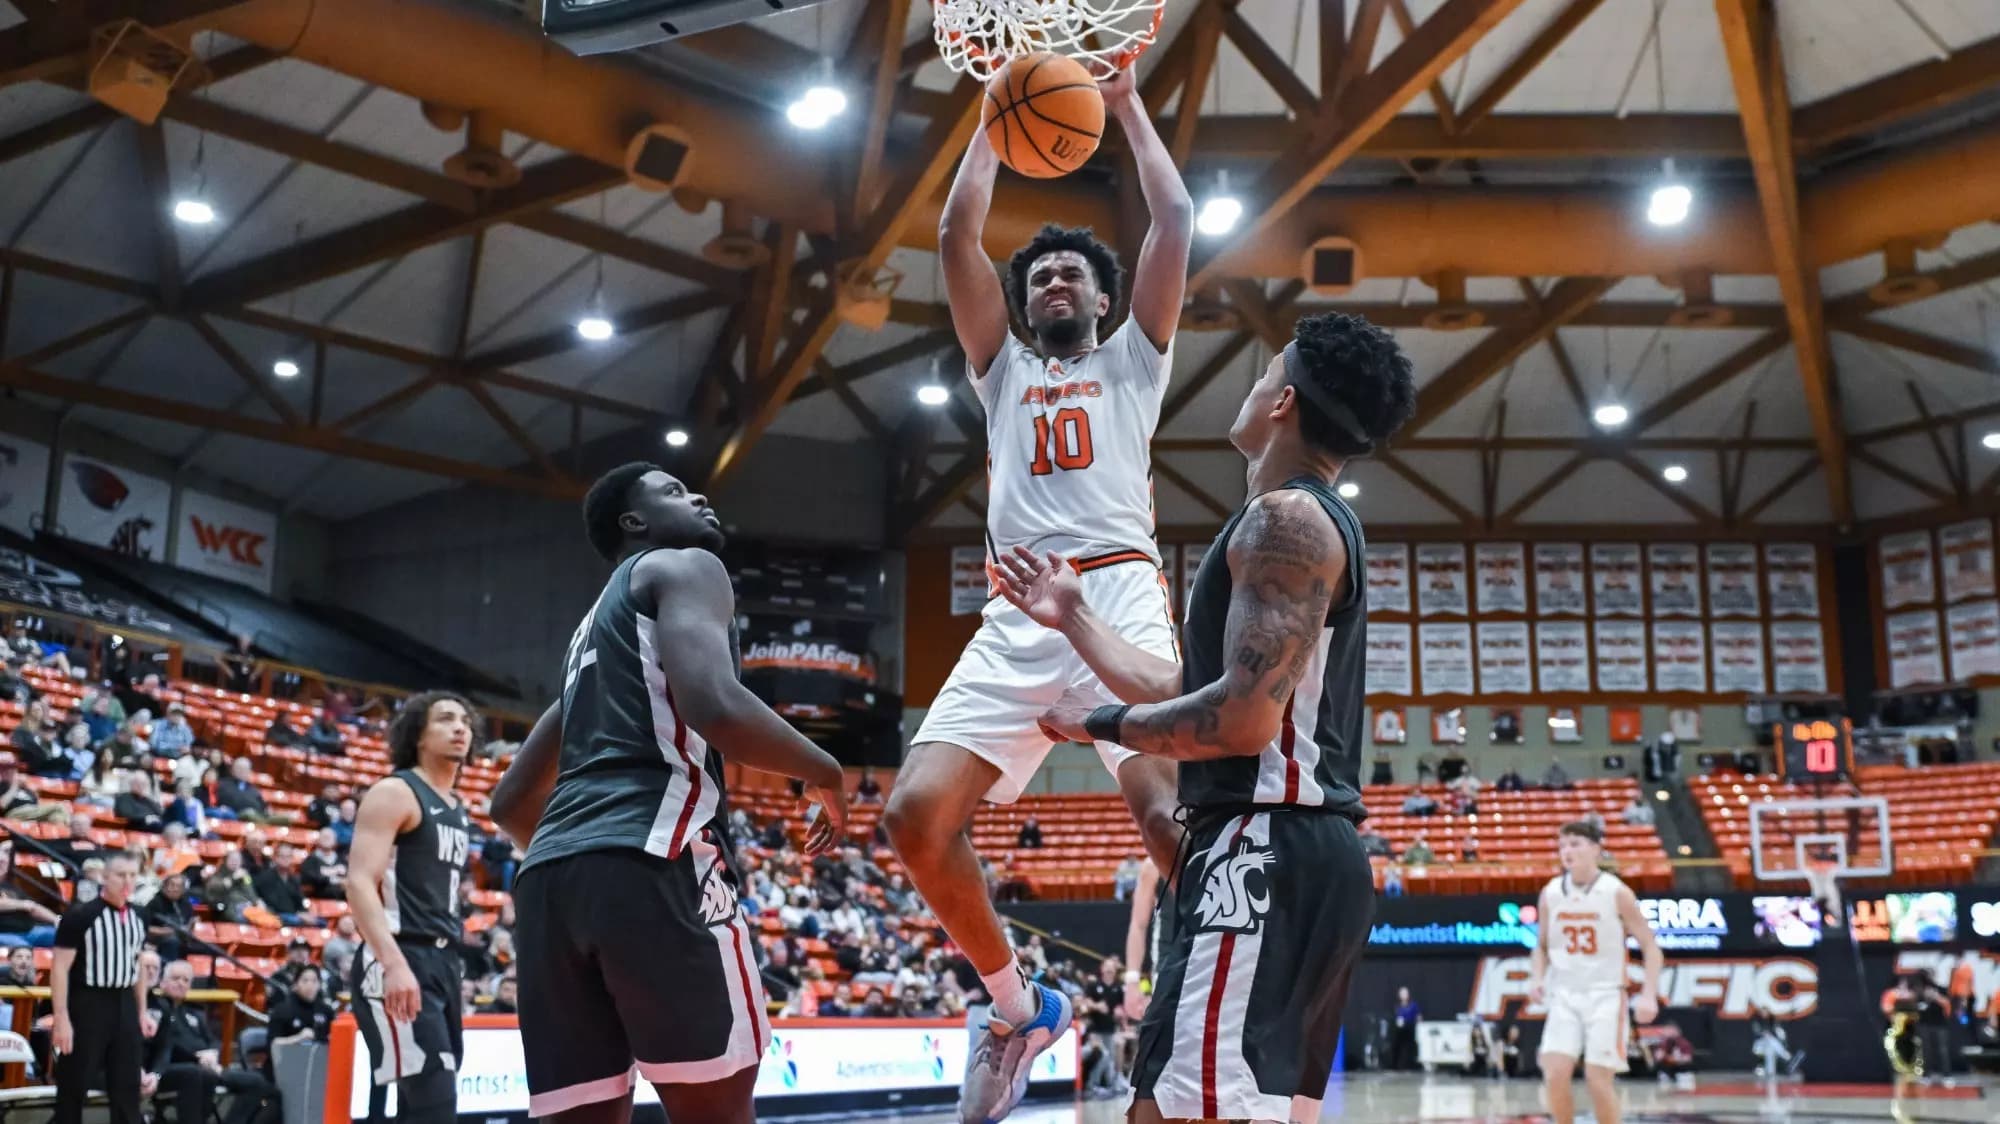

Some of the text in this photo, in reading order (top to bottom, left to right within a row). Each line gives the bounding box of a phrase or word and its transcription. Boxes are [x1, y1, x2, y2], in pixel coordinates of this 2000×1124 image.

[1030, 407, 1094, 476] 10
[189, 514, 267, 568] WCC
[1635, 898, 1729, 929] ERRA
[1562, 925, 1598, 955] 33
